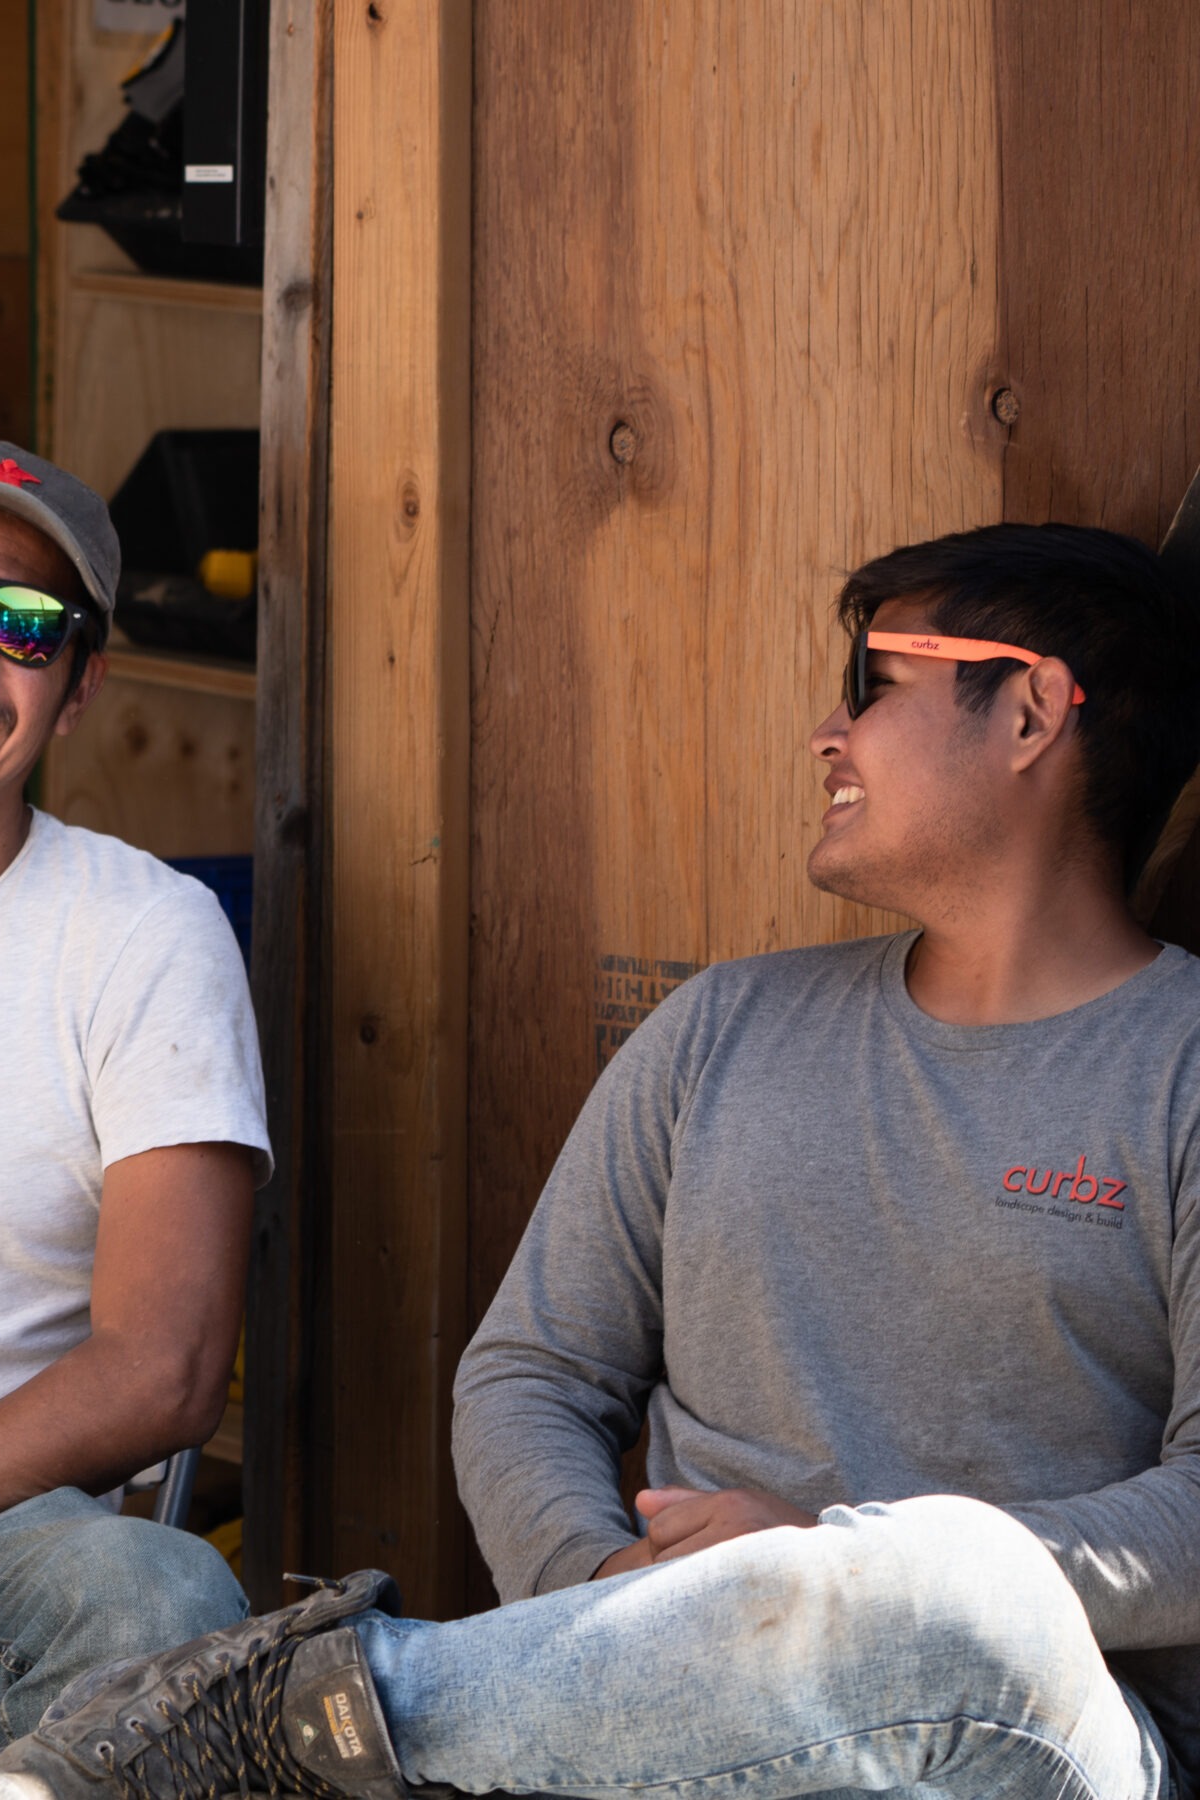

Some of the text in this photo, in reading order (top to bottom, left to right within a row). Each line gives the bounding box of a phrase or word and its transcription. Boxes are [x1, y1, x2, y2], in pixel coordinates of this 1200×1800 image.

[911, 638, 940, 650] curbz
[1002, 1154, 1129, 1212] curbz
[994, 1196, 1124, 1230] landscape design & build
[335, 1692, 362, 1757] DAKOTA
